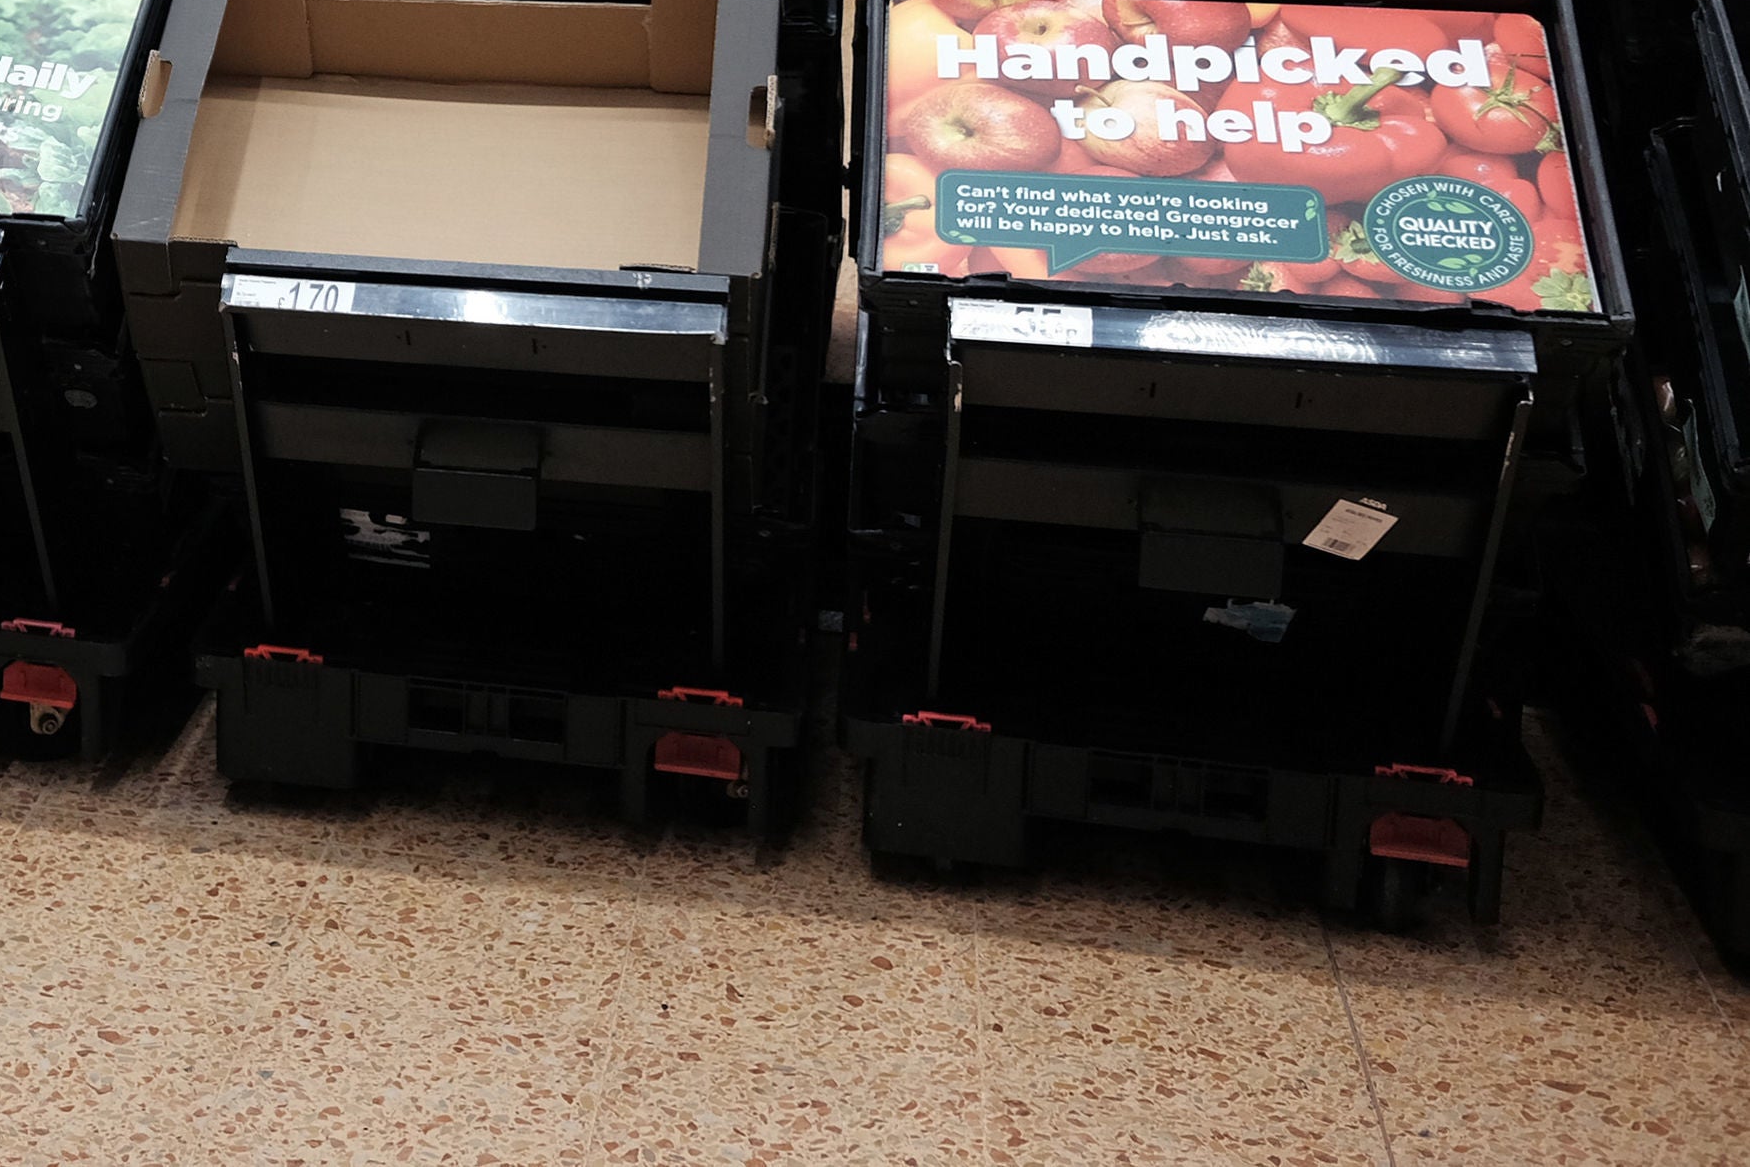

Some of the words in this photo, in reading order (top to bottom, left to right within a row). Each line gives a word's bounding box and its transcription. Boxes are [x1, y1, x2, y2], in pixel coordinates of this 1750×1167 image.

[936, 34, 1492, 92] Handpicked
[1051, 100, 1140, 142] to
[1156, 100, 1335, 152] help
[957, 185, 1010, 199] Can't
[1015, 186, 1056, 202] find
[1061, 189, 1112, 204] what
[1118, 193, 1183, 209] you're
[1189, 195, 1268, 213] looking
[1376, 183, 1428, 216] CHOSEN
[1433, 182, 1474, 198] WITH
[1479, 195, 1516, 225] CARE
[956, 200, 997, 214] for?
[1003, 202, 1049, 216] Your
[1055, 206, 1159, 222] dedicated
[1166, 210, 1299, 230] Greengrocer
[957, 216, 992, 230] will
[998, 218, 1024, 231] be
[1030, 219, 1094, 236] happy
[1100, 222, 1122, 236] to
[1128, 223, 1180, 240] help.
[1186, 227, 1230, 241] Just
[1236, 230, 1278, 244] ask.
[1399, 216, 1493, 235] QUALITY
[1400, 233, 1496, 250] CHECKED
[1373, 227, 1393, 252] FOR
[1388, 253, 1474, 287] FRESHNESS
[1479, 265, 1509, 284] AND
[1508, 235, 1524, 266] TASTE
